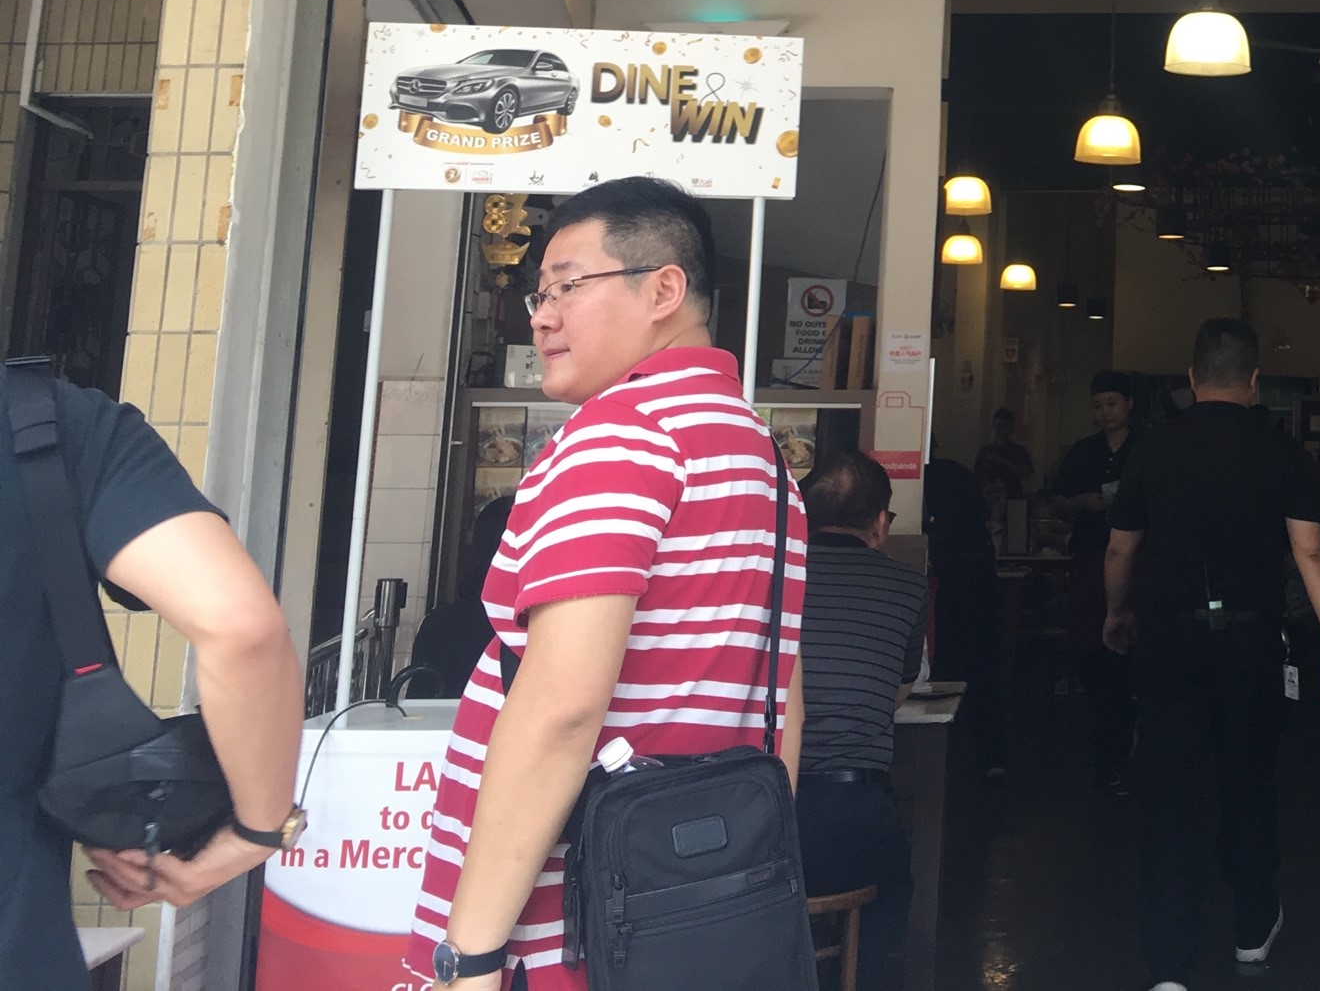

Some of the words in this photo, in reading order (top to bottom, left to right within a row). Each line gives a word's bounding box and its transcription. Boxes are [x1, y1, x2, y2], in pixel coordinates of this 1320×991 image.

[590, 62, 698, 105] DINE
[671, 100, 764, 144] WIN
[426, 128, 486, 149] GRAND
[491, 132, 542, 149] PRIZE
[796, 329, 820, 337] FOOD
[380, 806, 410, 830] to
[314, 848, 329, 868] a
